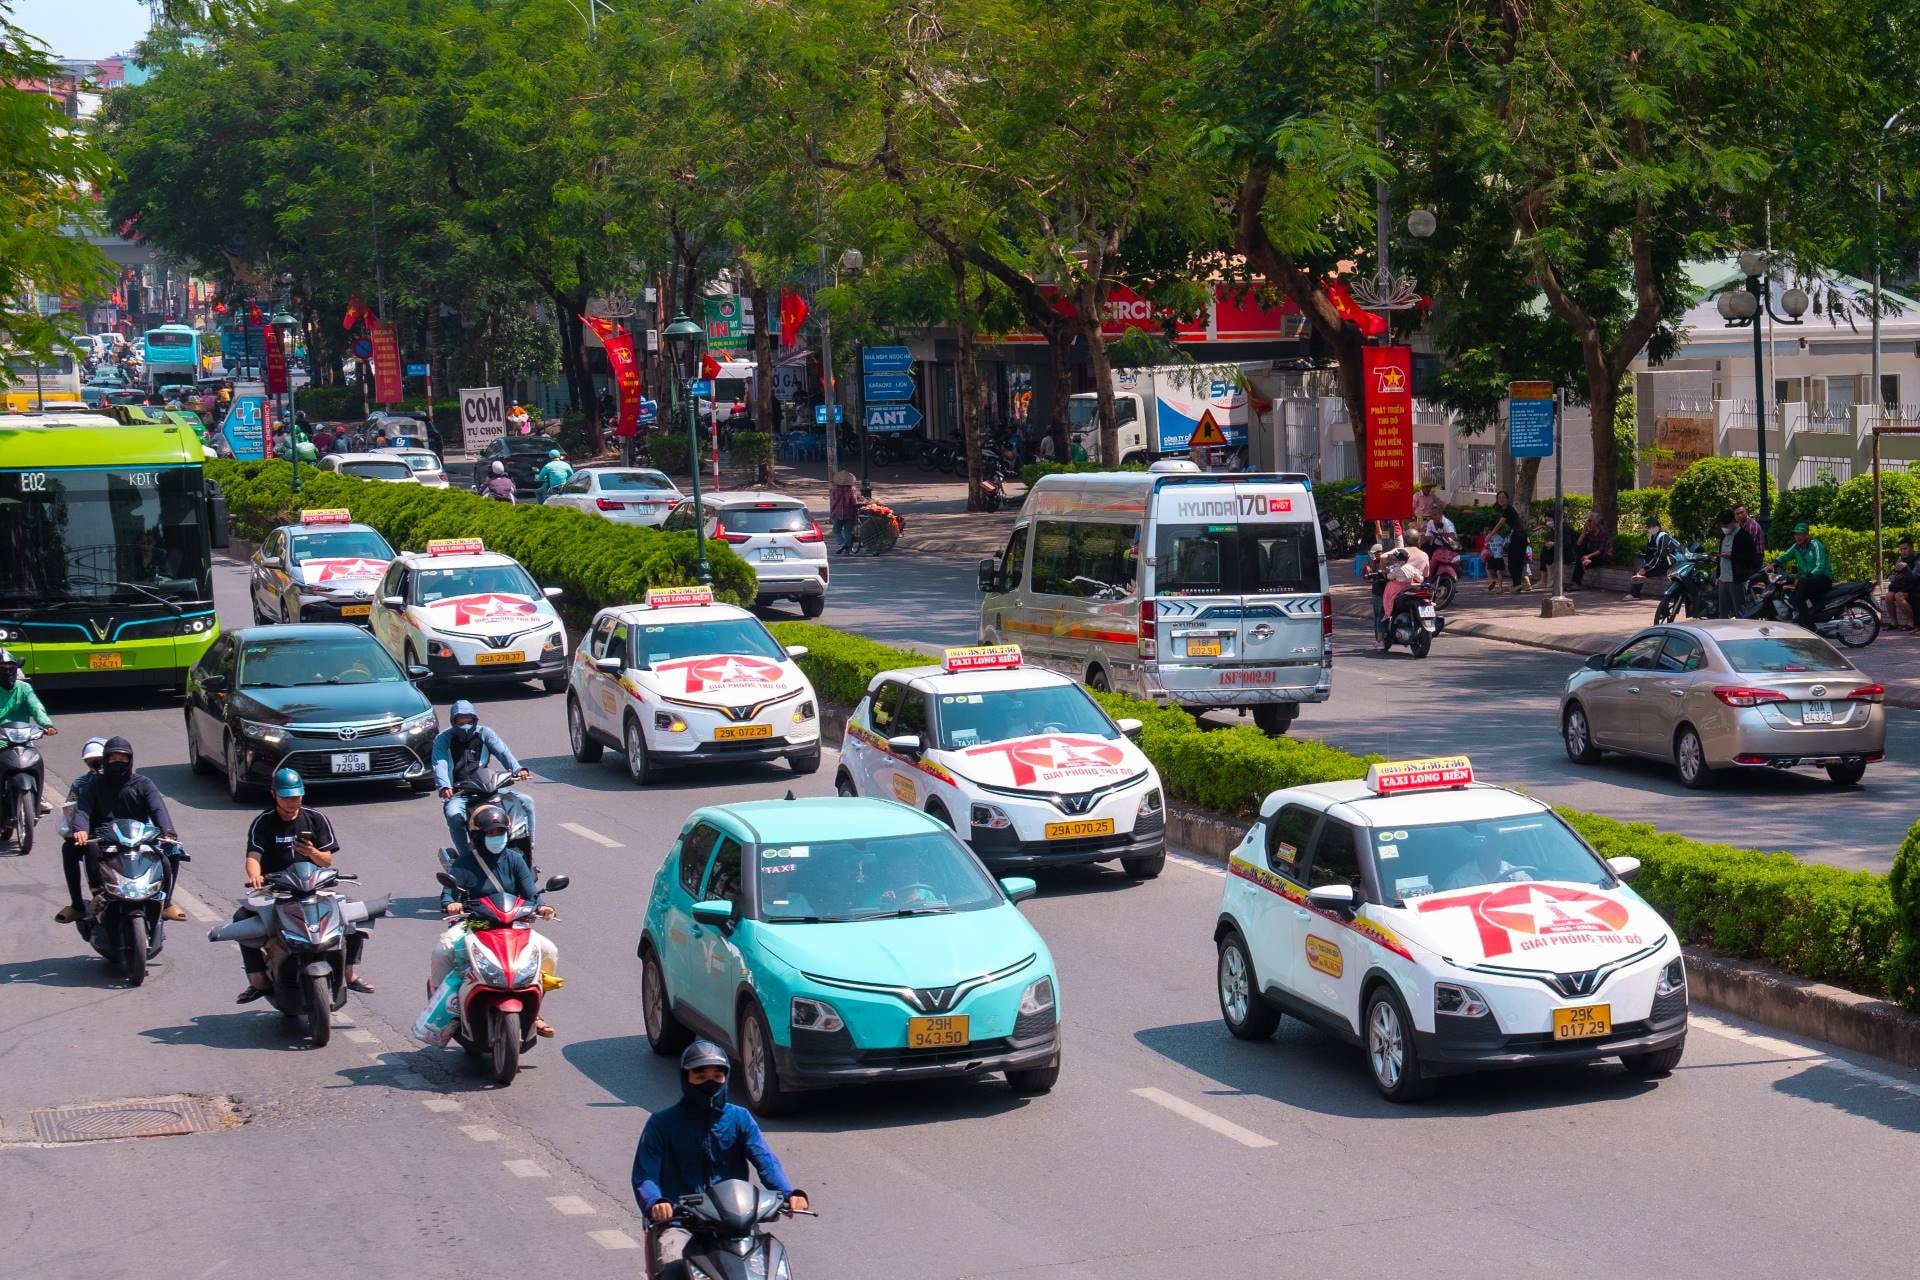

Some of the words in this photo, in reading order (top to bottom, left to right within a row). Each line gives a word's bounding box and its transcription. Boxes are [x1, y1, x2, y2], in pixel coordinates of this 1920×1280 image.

[465, 392, 502, 423] CƠM
[870, 410, 907, 425] ANT
[21, 473, 46, 492] E02
[129, 473, 151, 486] KĐT
[1178, 501, 1238, 518] HYUNDAI
[1237, 495, 1268, 516] 170
[950, 657, 971, 666] TAXI
[973, 656, 997, 665] LONG
[998, 653, 1019, 663] BIÊN
[342, 754, 359, 764] 30G
[1381, 774, 1408, 787] TAXI
[1410, 773, 1440, 784] LONG
[1442, 769, 1469, 780] BIÊN
[1052, 821, 1108, 836] 29A-070.25
[1570, 1008, 1593, 1022] 29K
[927, 1019, 952, 1031] 29H
[1561, 1021, 1605, 1037] 017.29
[916, 1031, 962, 1046] 943.50
